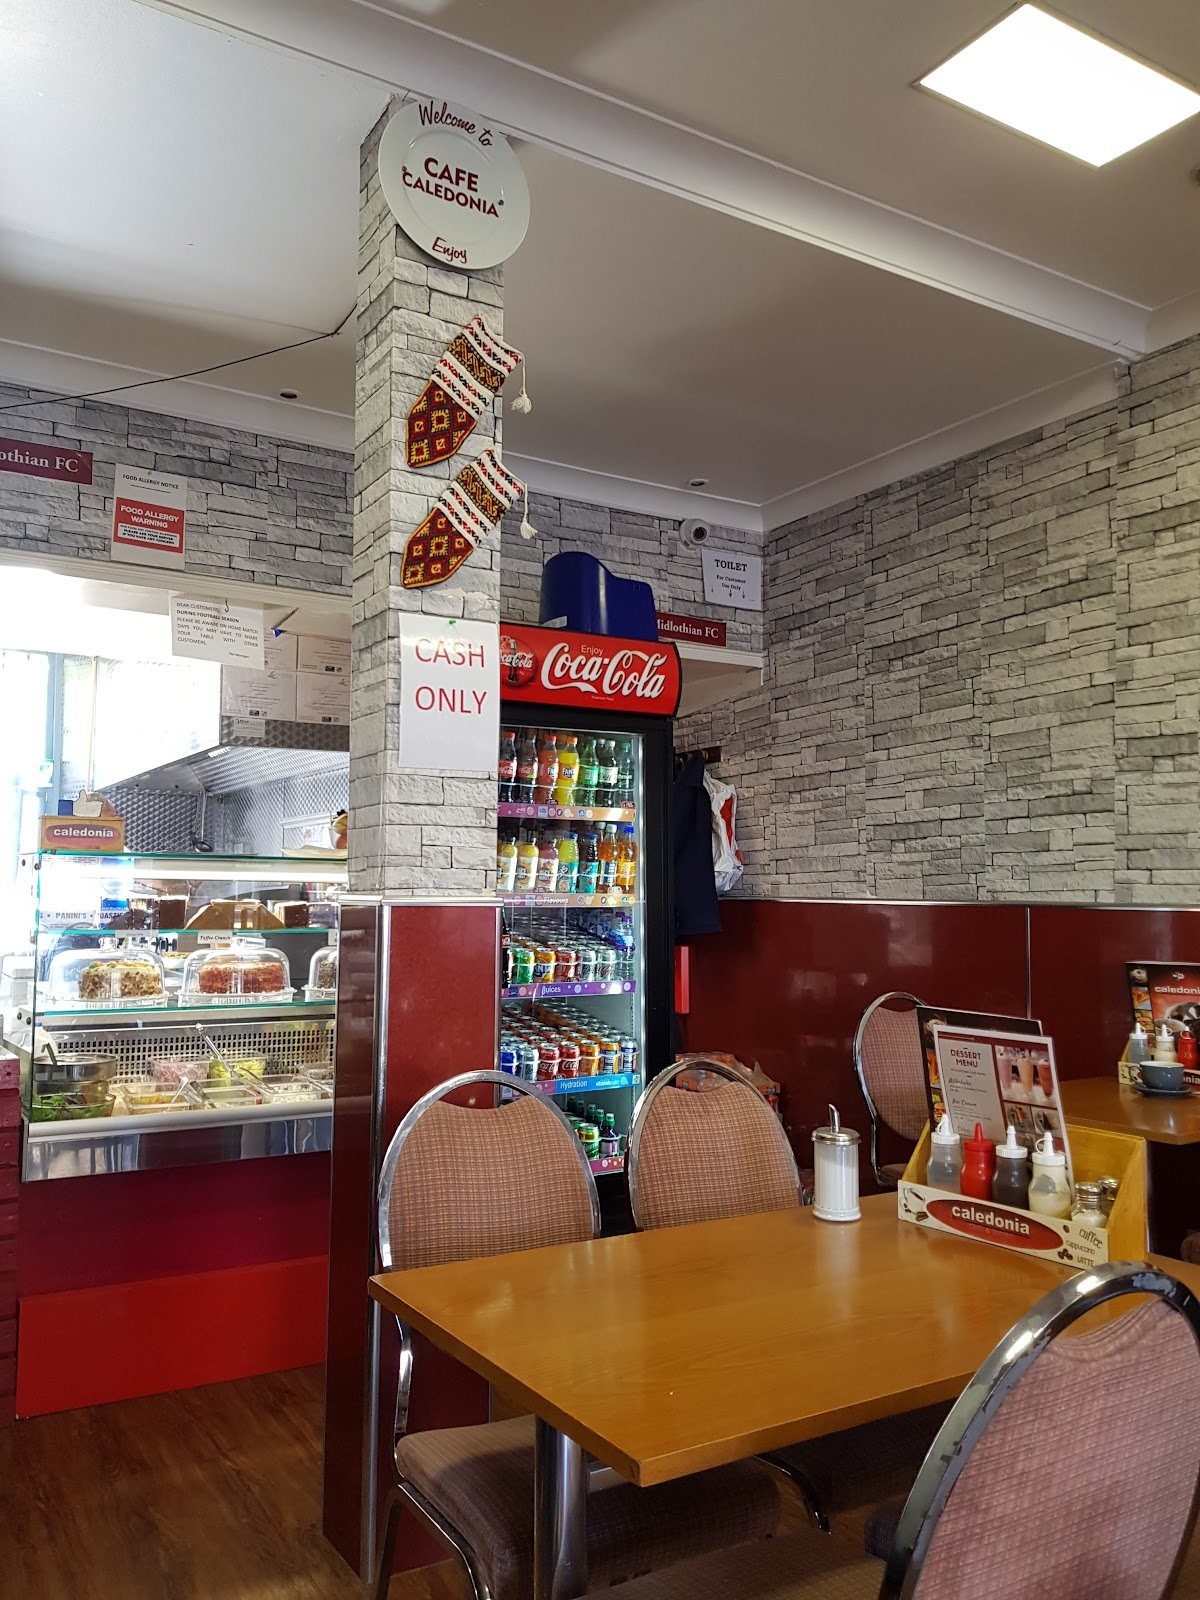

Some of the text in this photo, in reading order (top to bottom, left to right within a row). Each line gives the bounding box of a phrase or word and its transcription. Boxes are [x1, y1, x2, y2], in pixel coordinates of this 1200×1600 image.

[419, 100, 493, 146] Welcome to
[424, 157, 478, 193] CAFE
[402, 172, 498, 218] CALEDONIA
[432, 237, 467, 264] Enjoy
[55, 457, 78, 473] FC
[121, 505, 179, 522] FOOD ALLERGY
[131, 516, 168, 528] WARNING
[715, 559, 747, 572] TOILET
[705, 627, 719, 638] FC
[416, 638, 484, 668] CASH
[581, 645, 603, 655] Enjoy
[541, 642, 668, 699] Coca-Cola
[416, 686, 487, 714] ONLY
[53, 828, 114, 838] caledonia
[950, 1049, 981, 1060] DESSERT
[956, 1059, 978, 1068] MENU
[561, 1080, 587, 1090] Hydration
[952, 1205, 1030, 1235] caledonia
